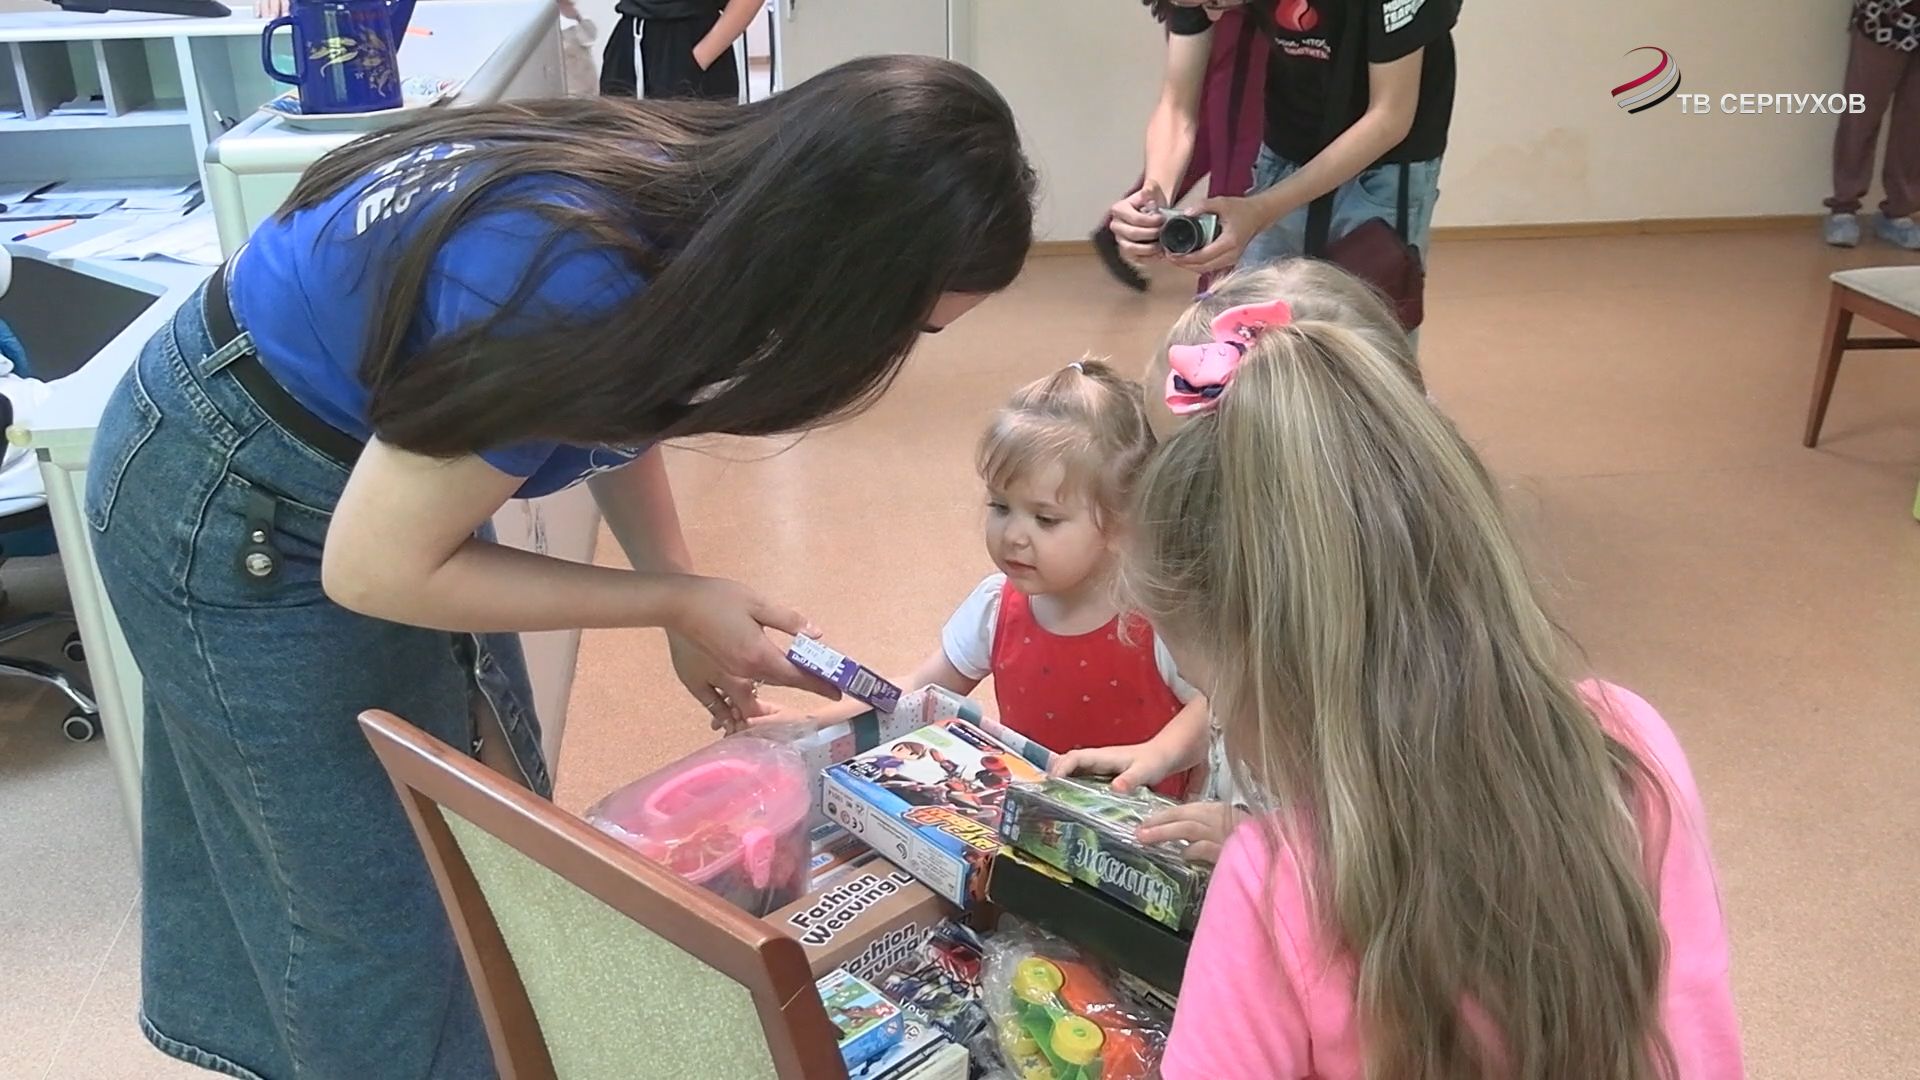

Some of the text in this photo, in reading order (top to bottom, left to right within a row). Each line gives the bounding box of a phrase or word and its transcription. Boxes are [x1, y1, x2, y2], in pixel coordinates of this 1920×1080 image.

[790, 872, 880, 930] Fashion
[1073, 838, 1174, 910] ЭКОСИСТЕМА
[801, 880, 896, 946] Weaving
[861, 936, 920, 982] aving
